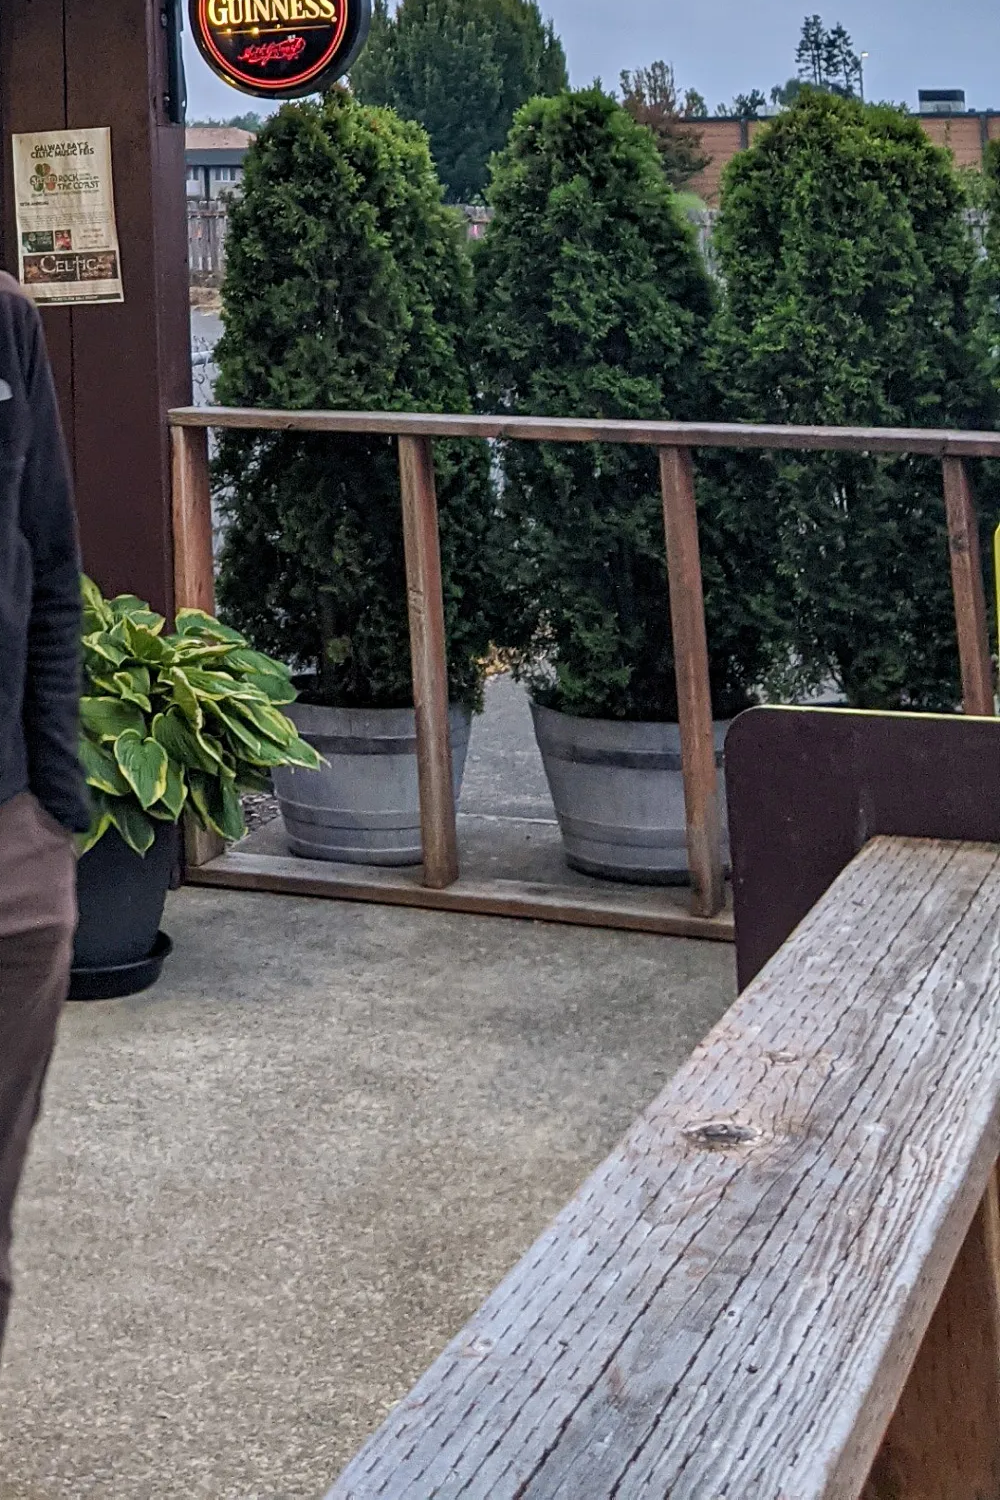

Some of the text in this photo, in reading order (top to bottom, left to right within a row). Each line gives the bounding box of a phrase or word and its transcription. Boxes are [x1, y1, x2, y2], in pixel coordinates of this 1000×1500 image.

[30, 150, 54, 159] CELTIC
[55, 148, 78, 157] MUSIC
[58, 172, 79, 182] ROCK
